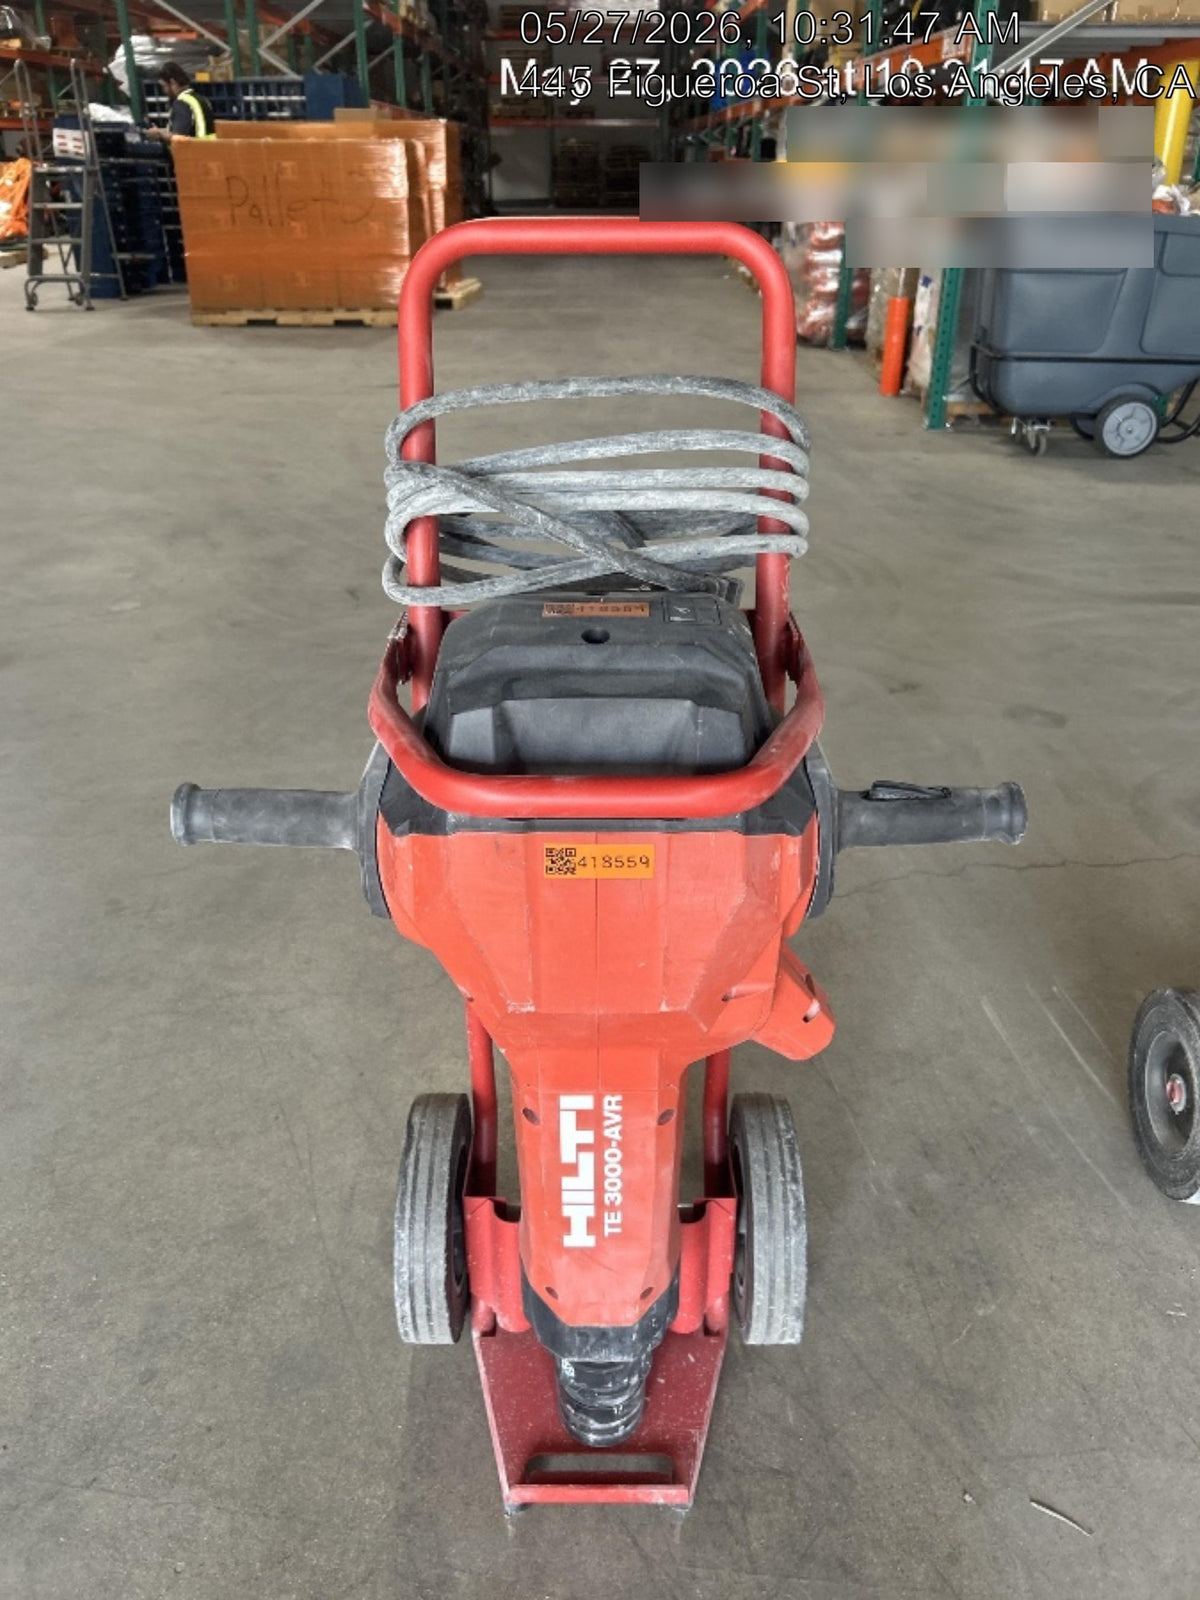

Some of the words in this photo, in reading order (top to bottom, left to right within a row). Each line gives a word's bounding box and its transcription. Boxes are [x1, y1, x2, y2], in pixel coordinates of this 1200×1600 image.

[577, 854, 650, 869] 418559
[559, 1094, 597, 1248] HILTI
[602, 1094, 623, 1207] 3000-AVR
[603, 1210, 623, 1238] TE
